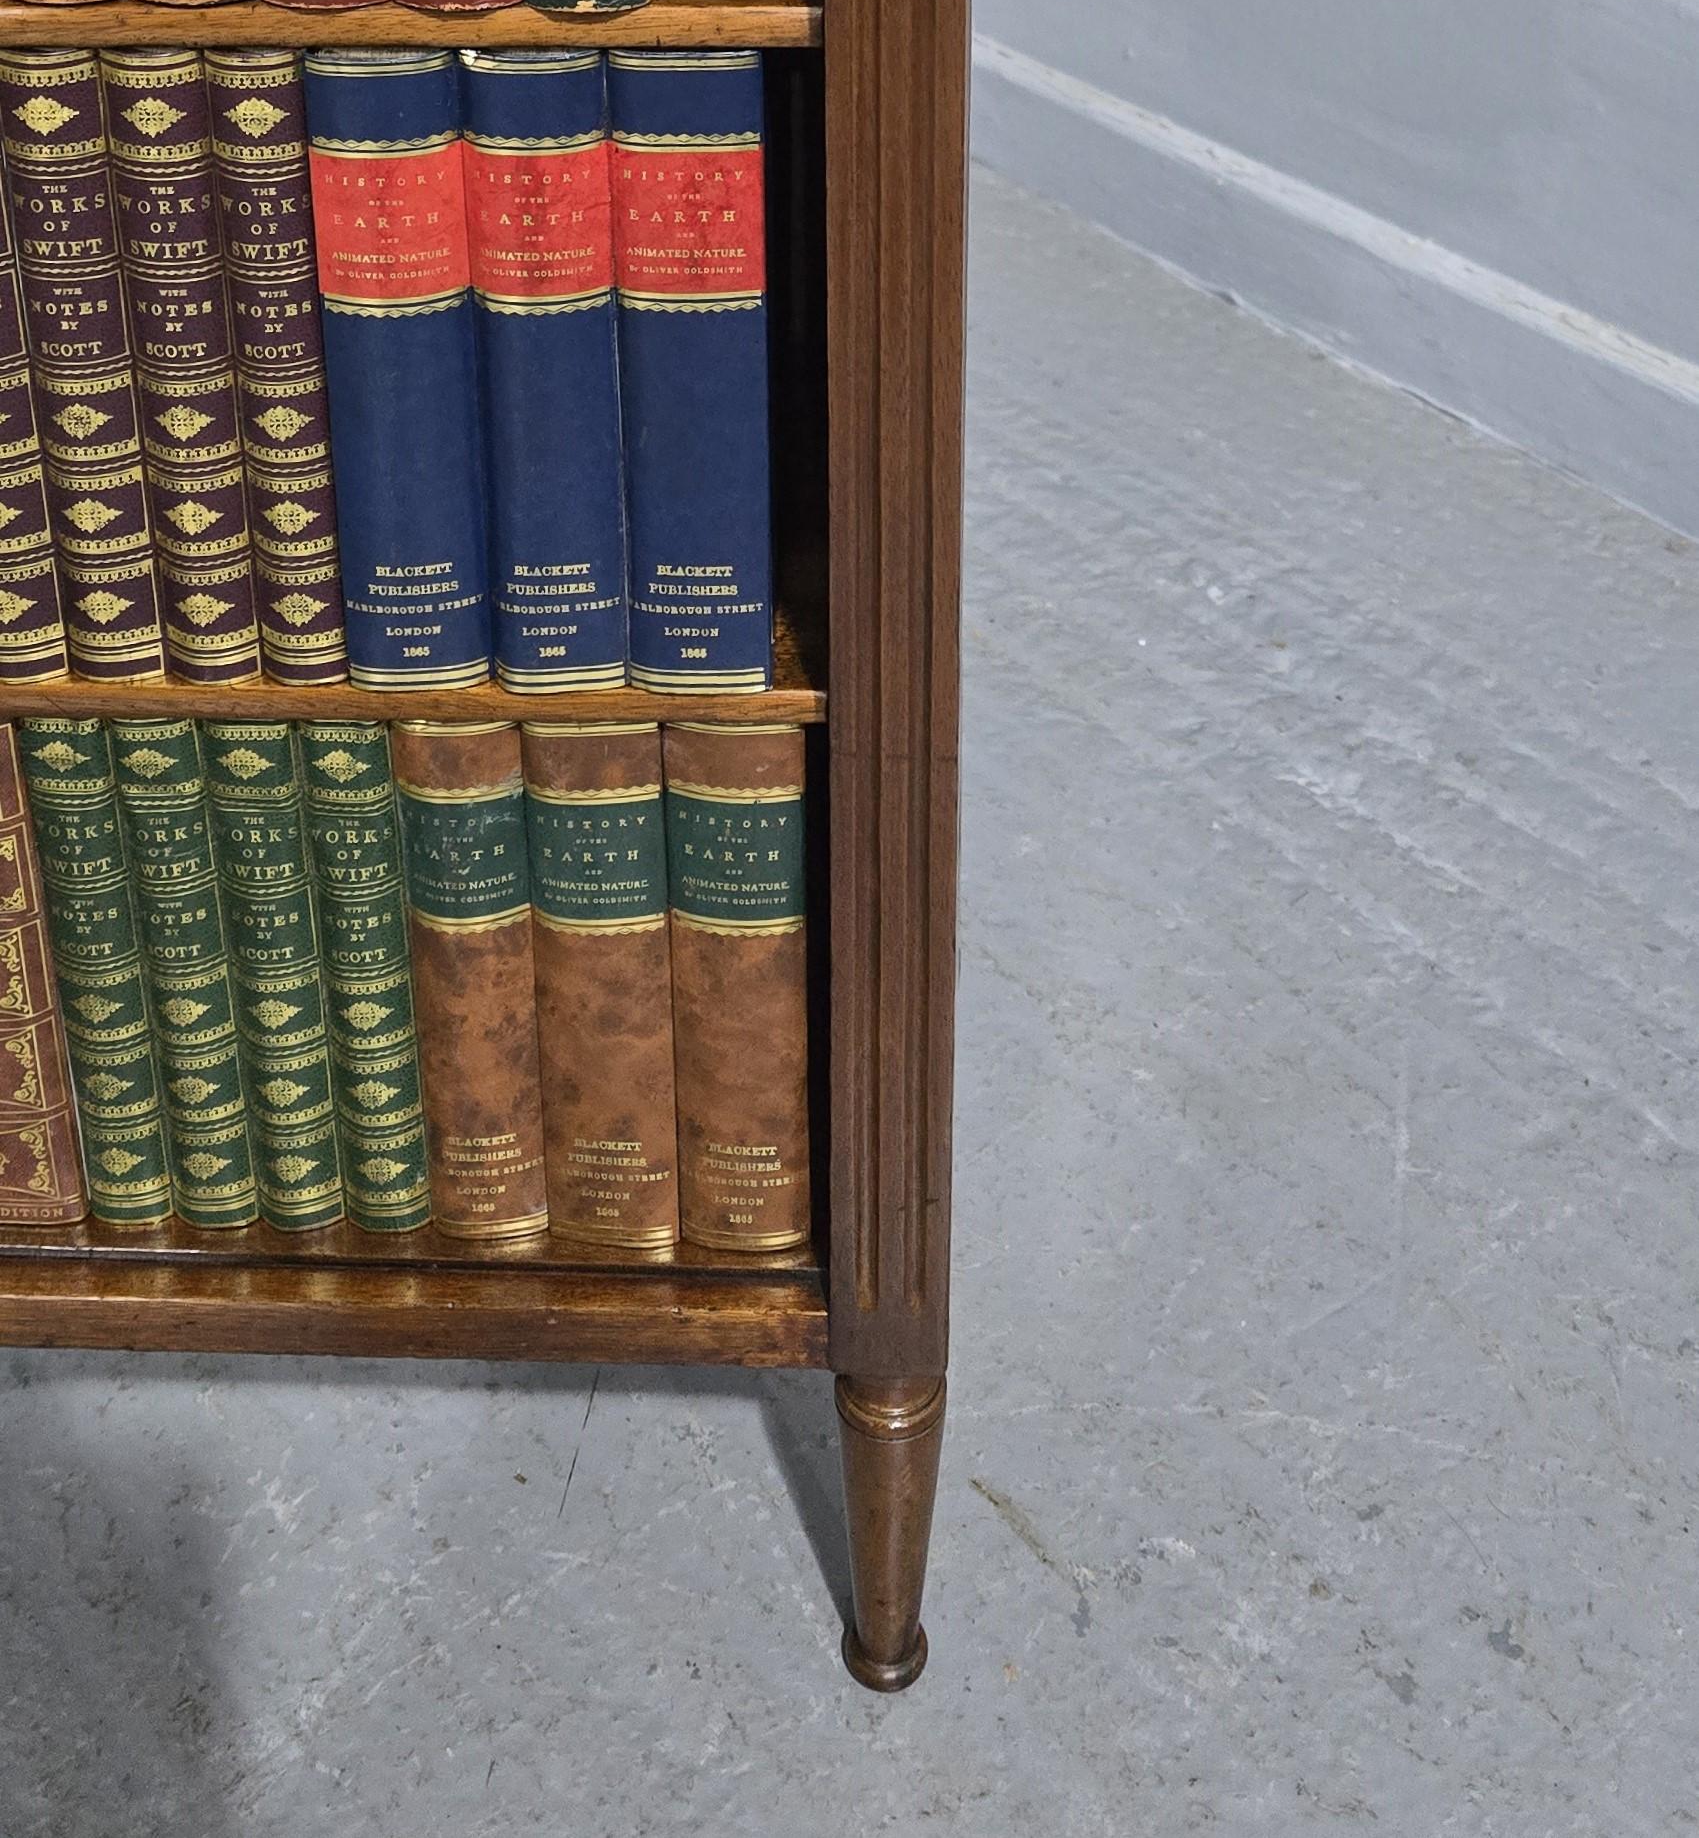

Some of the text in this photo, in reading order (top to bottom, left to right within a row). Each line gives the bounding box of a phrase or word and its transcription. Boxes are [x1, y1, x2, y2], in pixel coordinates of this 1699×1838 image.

[324, 170, 446, 187] HISTORY
[473, 170, 591, 184] HISTORY
[623, 170, 744, 182] HISTORY
[42, 185, 68, 193] THE
[149, 186, 175, 195] THE
[251, 187, 277, 196] THE
[13, 193, 105, 213] WORKS
[119, 193, 210, 215] WORKS
[220, 194, 310, 216] WORKS
[333, 212, 439, 229] EARTH
[480, 210, 584, 226] EARTH
[628, 209, 736, 223] EARTH
[43, 220, 70, 232] OF
[150, 221, 177, 233] OF
[250, 223, 278, 235] OF
[24, 238, 103, 257] SWIFT
[130, 239, 208, 259] SWIFT
[232, 238, 308, 260] SWIFT
[482, 247, 595, 262] ANIMATED NATURE
[626, 247, 747, 259] ANIMATED NATURE
[331, 248, 451, 264] ANIMATED NATURE
[31, 299, 108, 316] NOTES
[136, 300, 212, 317] NOTES
[236, 300, 312, 319] NOTES
[61, 321, 79, 330] BY
[165, 322, 184, 332] BY
[264, 323, 284, 333] BY
[41, 341, 102, 357] SCOTT
[145, 342, 207, 358] SCOTT
[244, 342, 305, 359] SCOTT
[375, 562, 453, 578] BLACKETT
[514, 564, 591, 577] BLACKETT
[656, 564, 733, 578] BLACKETT
[368, 581, 459, 596] PUBLISHERS
[506, 582, 596, 596] PUBLISHERS
[648, 583, 738, 596] PUBLISHERS
[386, 625, 442, 637] LONDON
[522, 625, 578, 636] LONDON
[664, 627, 720, 637] LONDON
[537, 816, 646, 829] HISTORY
[679, 811, 787, 828] HISTORY
[59, 845, 83, 855] OF
[148, 848, 173, 857] OF
[243, 849, 266, 859] OF
[337, 850, 362, 860] OF
[544, 848, 639, 862] EARTH
[685, 844, 779, 862] EARTH
[542, 878, 649, 891] ANIMATED NATURE
[682, 876, 790, 892] ANIMATED NATURE
